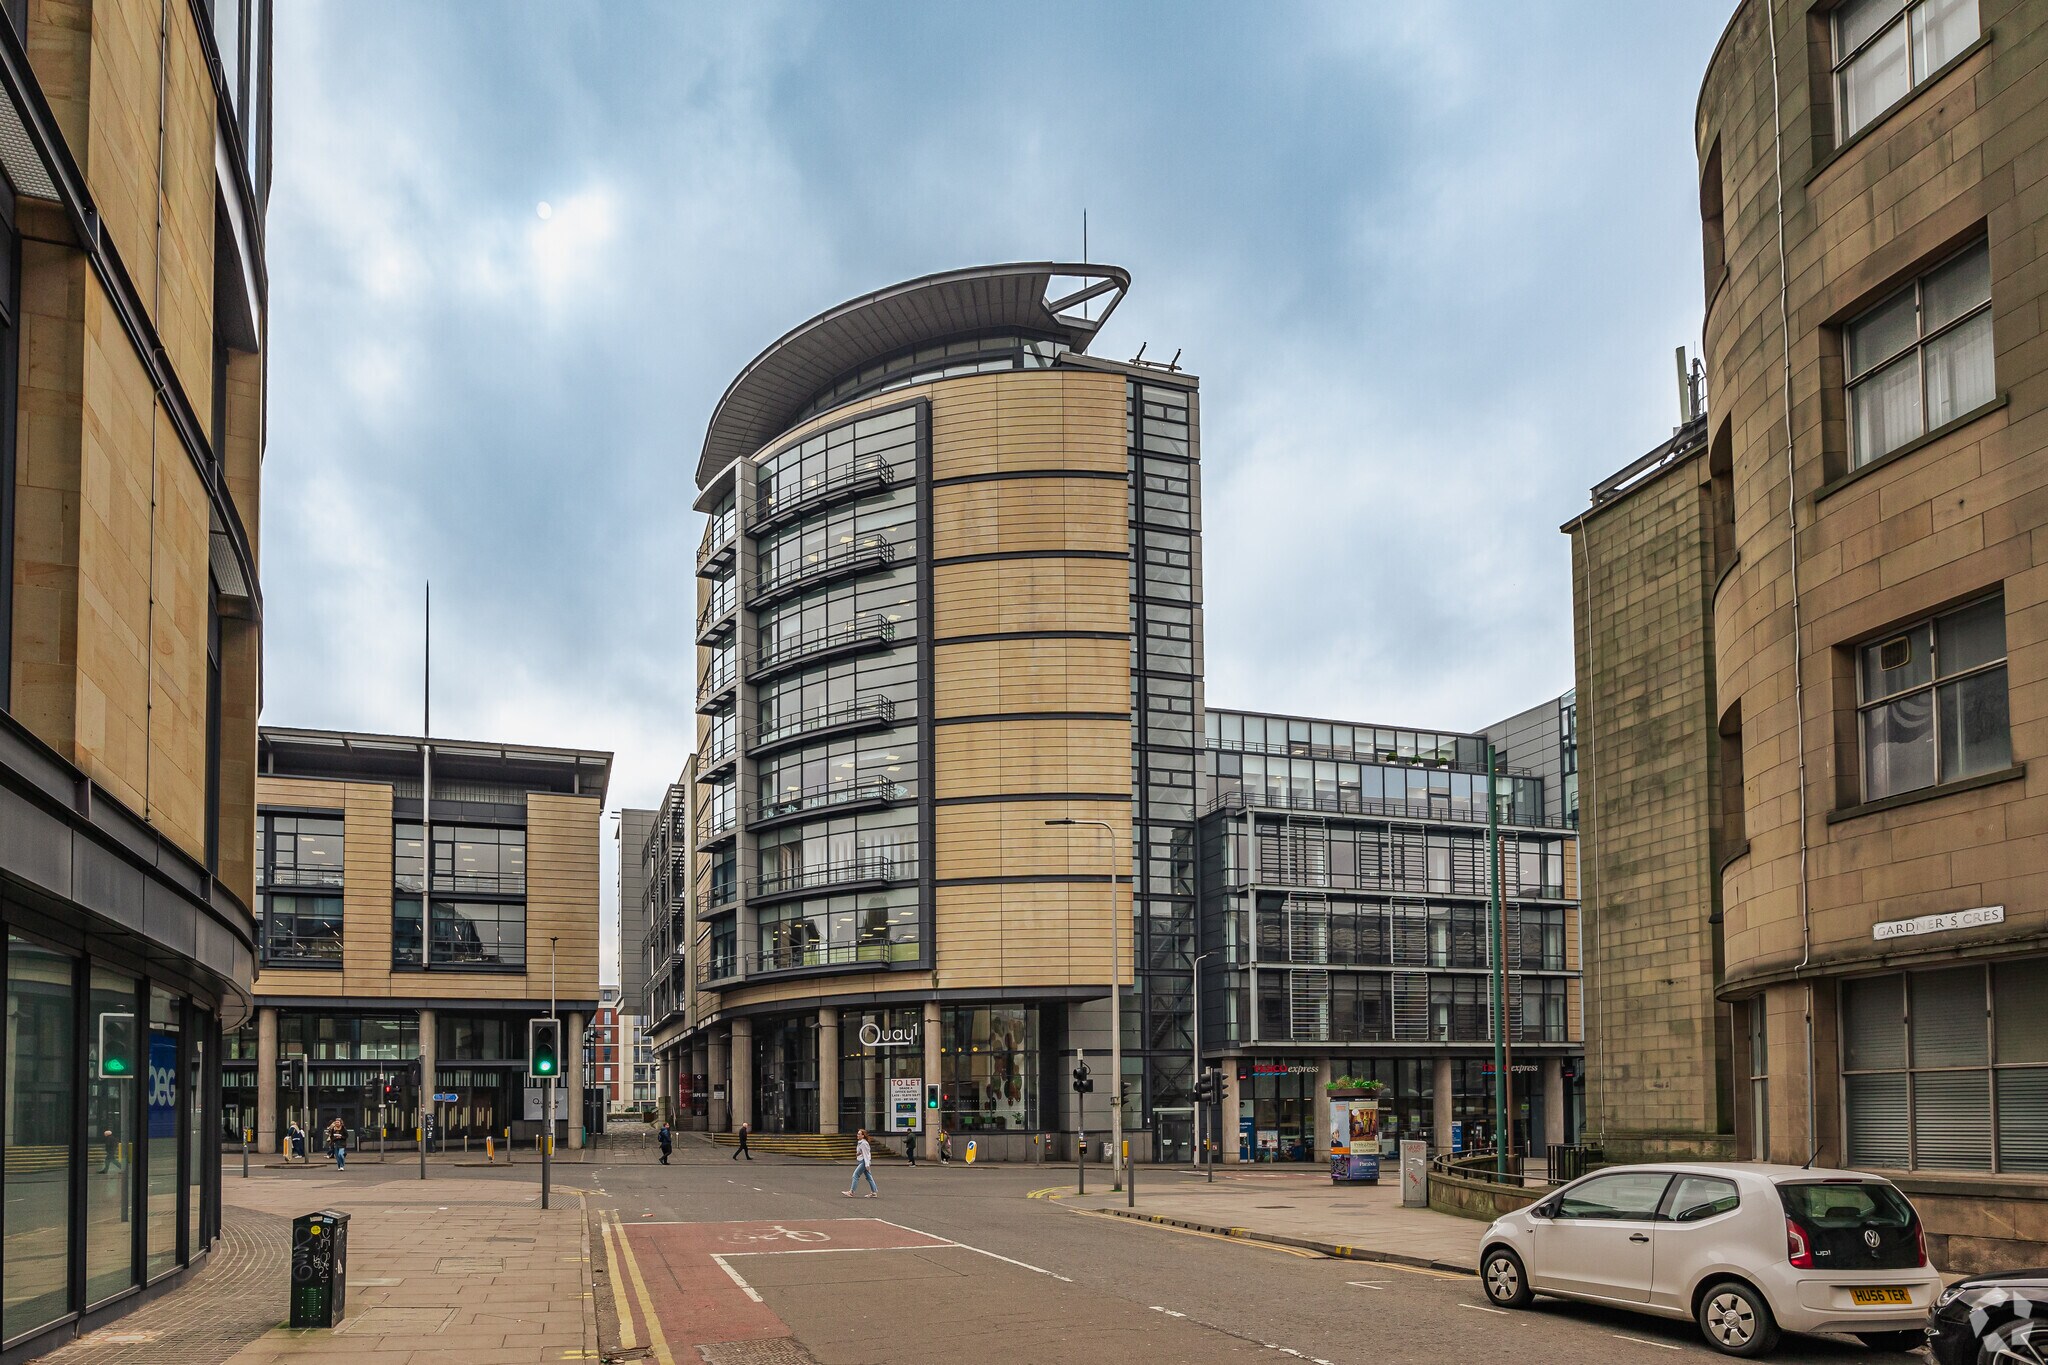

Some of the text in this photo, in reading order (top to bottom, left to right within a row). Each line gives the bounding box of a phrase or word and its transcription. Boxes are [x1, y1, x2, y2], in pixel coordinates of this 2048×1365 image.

[1877, 909, 1999, 937] GARDNER'S CRES
[1253, 1065, 1319, 1075] TESCO express
[1511, 1064, 1538, 1074] express
[905, 1079, 921, 1087] LET
[1815, 1249, 1831, 1257] up!
[1855, 1289, 1907, 1302] HU56 TER
